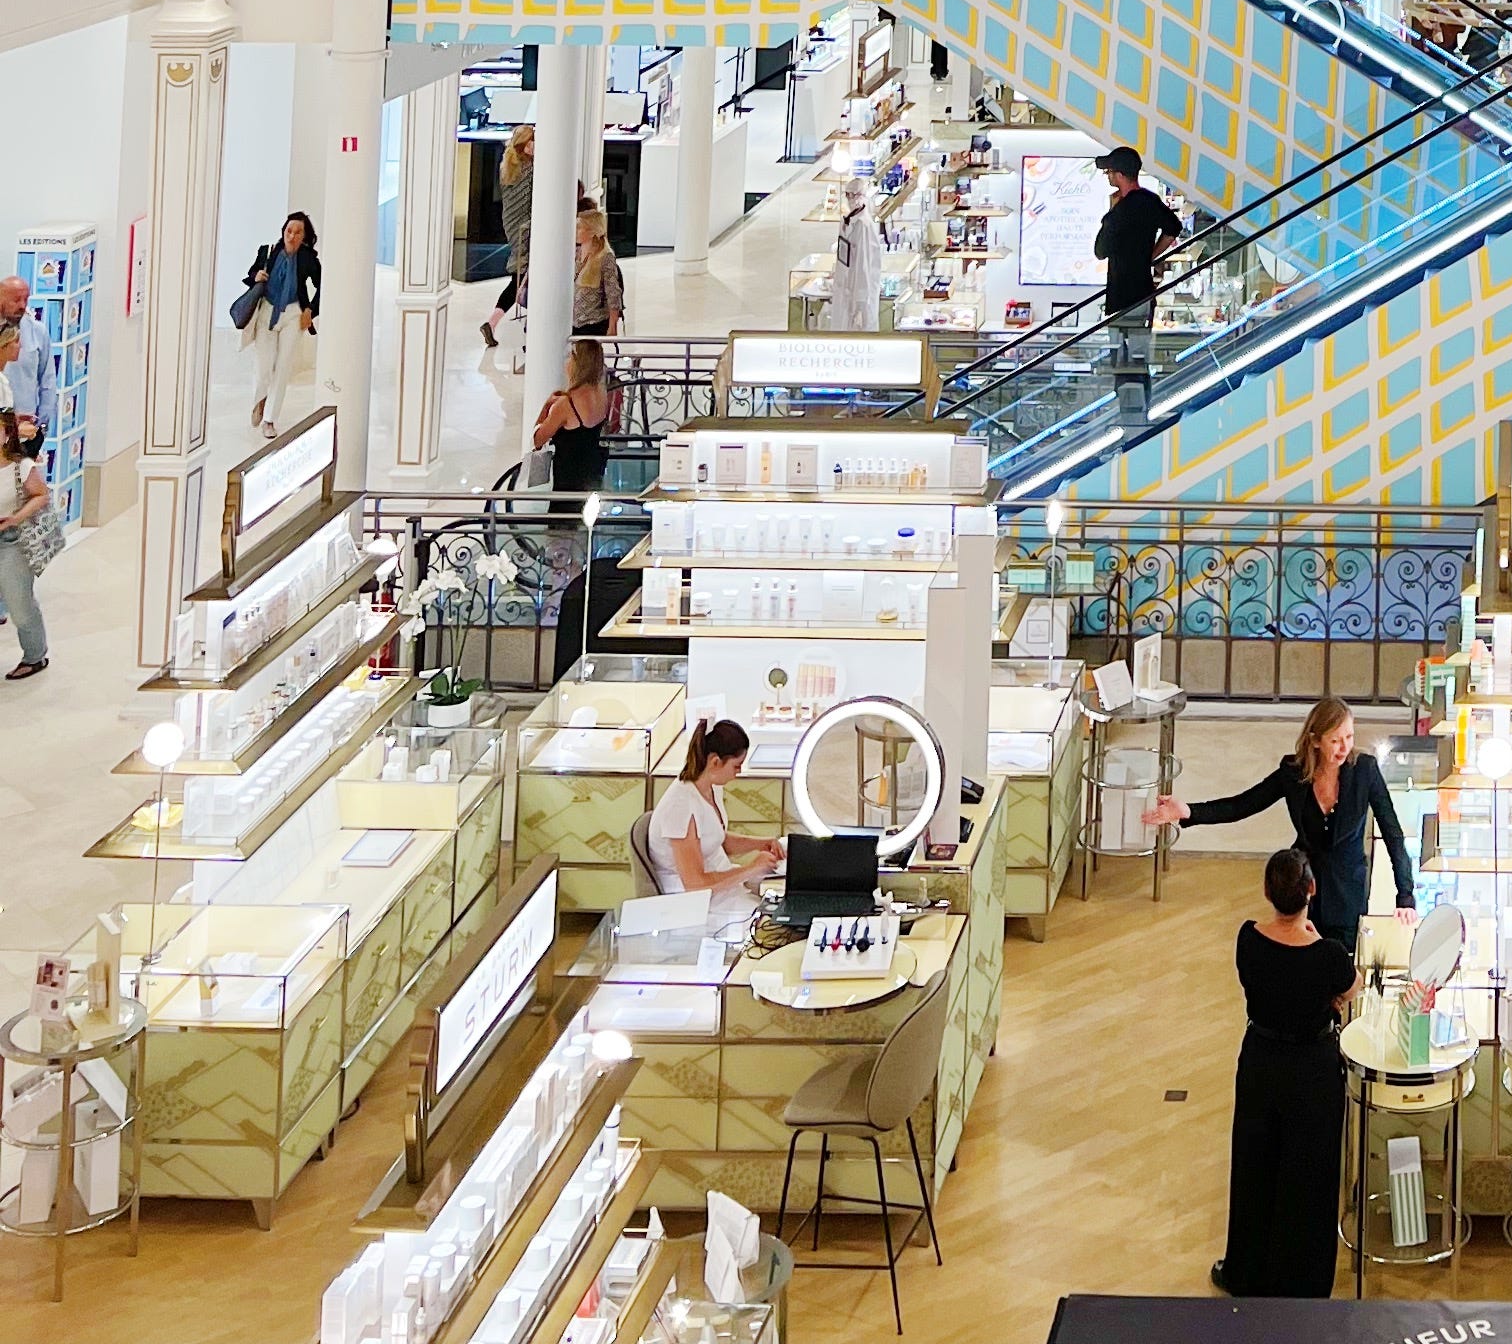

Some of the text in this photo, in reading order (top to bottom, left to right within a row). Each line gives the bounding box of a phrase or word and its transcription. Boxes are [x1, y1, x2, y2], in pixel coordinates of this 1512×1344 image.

[778, 343, 877, 357] BIOLOGIQUE
[778, 357, 876, 369] RECHERCHE
[463, 927, 533, 1045] STURM
